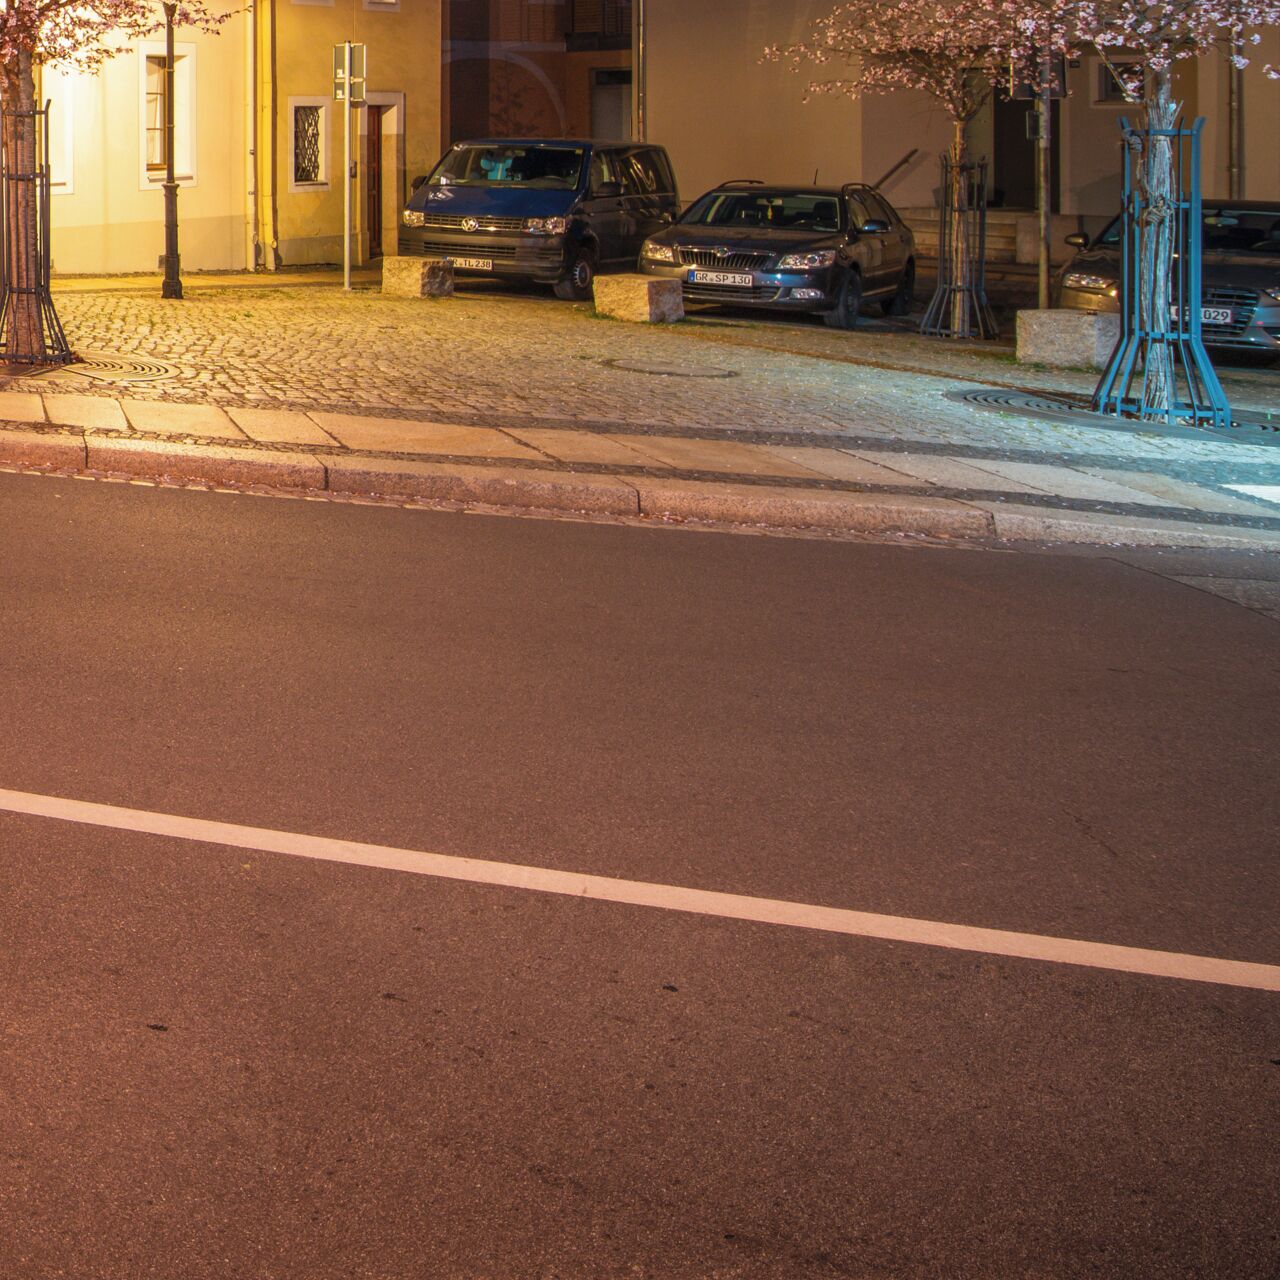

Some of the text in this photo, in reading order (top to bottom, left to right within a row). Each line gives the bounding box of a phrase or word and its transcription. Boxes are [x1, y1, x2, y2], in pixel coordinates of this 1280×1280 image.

[464, 259, 474, 267] TL
[475, 260, 491, 269] 238
[695, 272, 751, 285] GR SP 130
